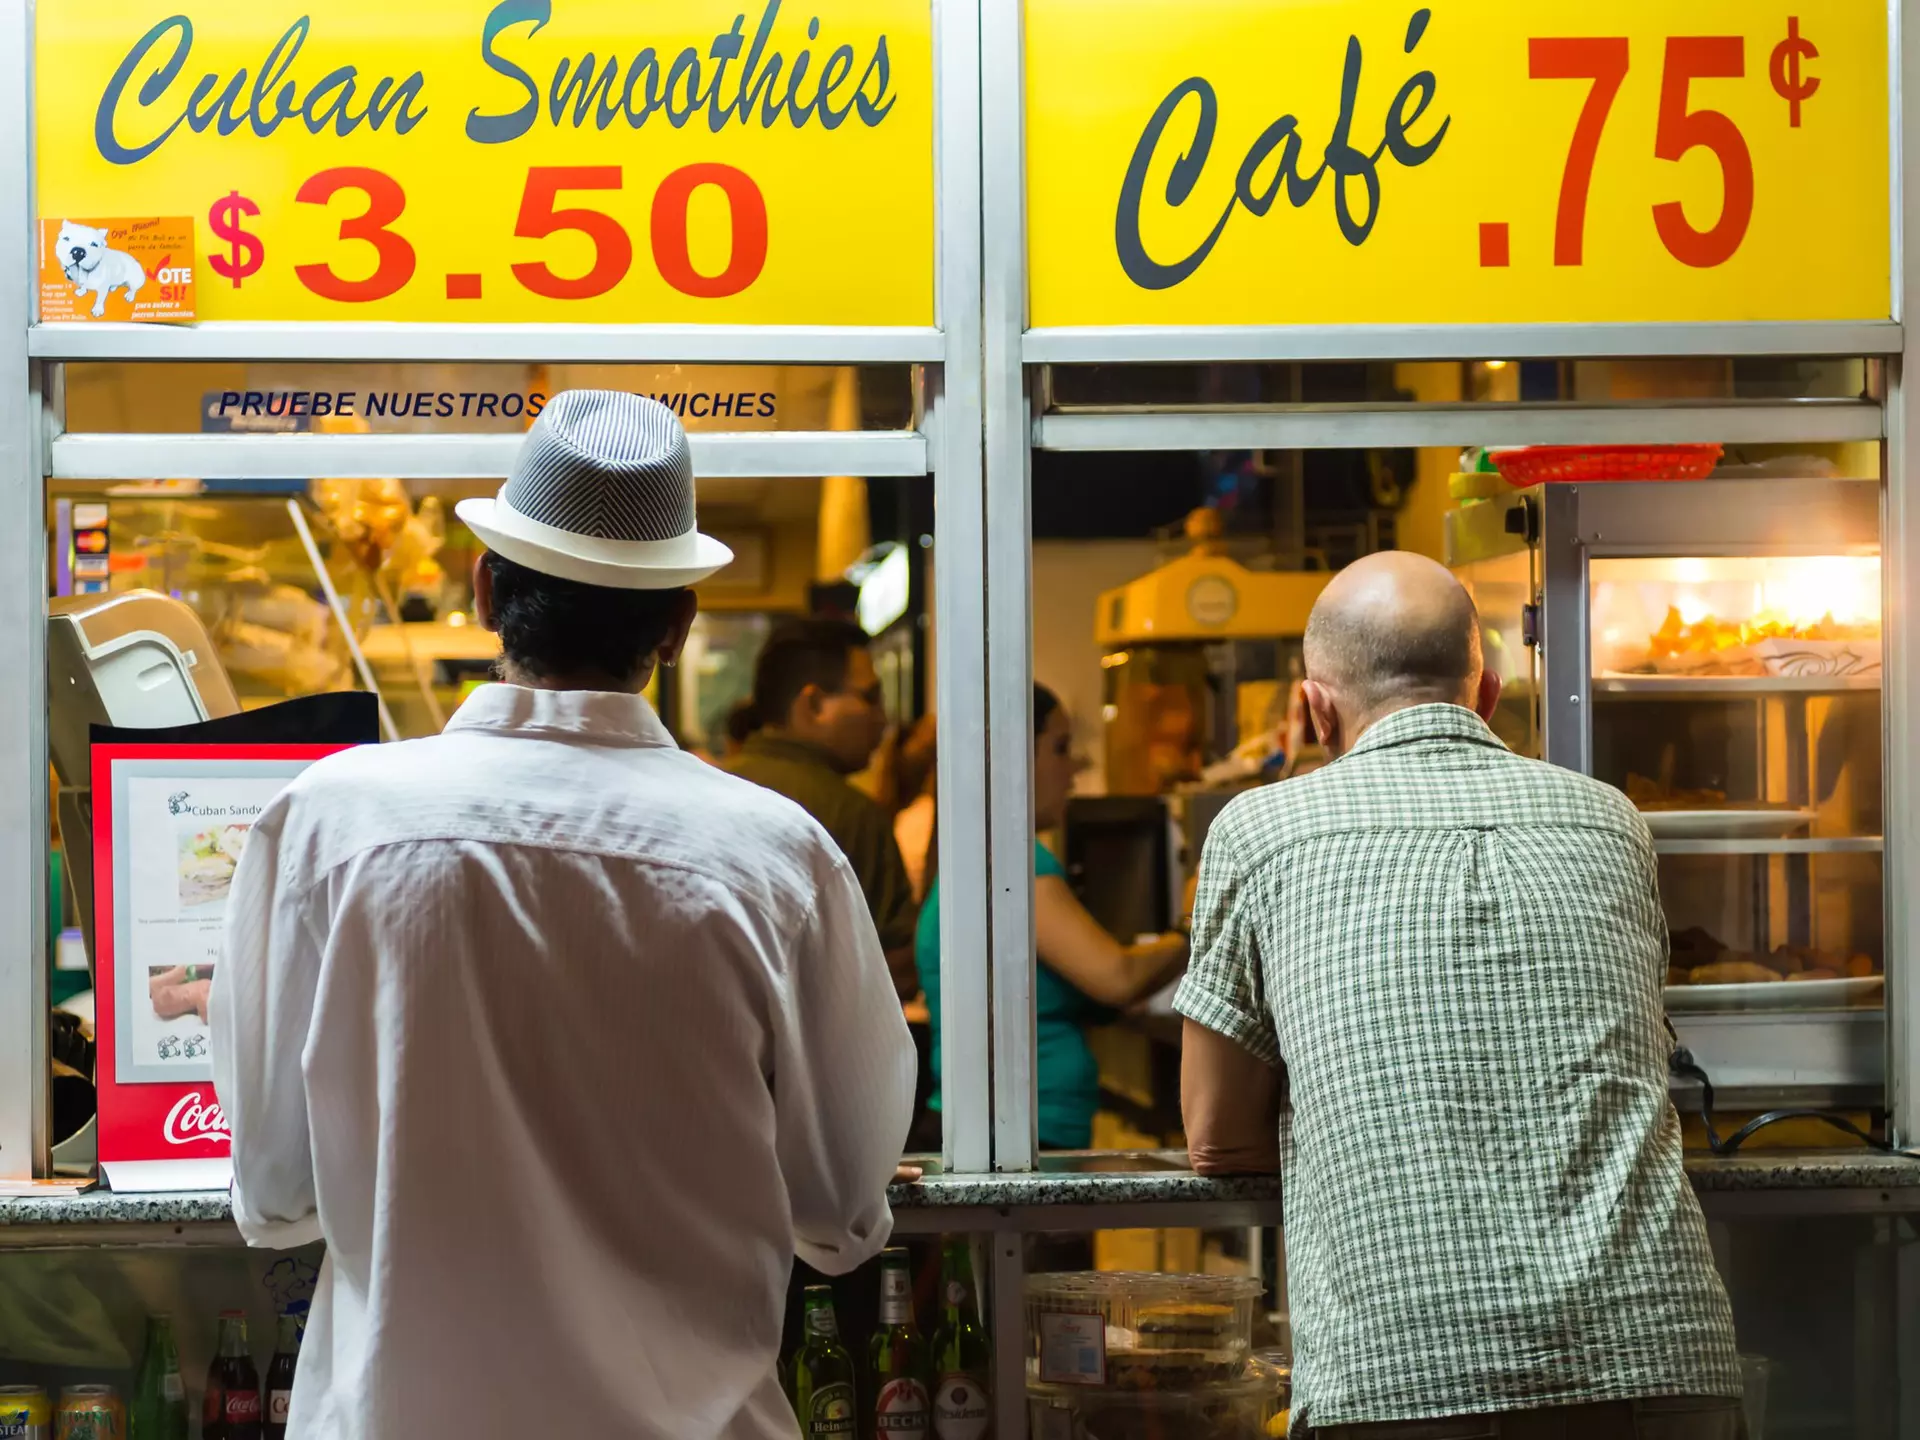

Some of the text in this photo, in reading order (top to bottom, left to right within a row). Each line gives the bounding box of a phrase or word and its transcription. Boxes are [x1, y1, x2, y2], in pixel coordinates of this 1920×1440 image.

[94, 0, 897, 165] Cuban Smoothies
[1114, 8, 1451, 291] Café
[218, 391, 356, 418] PRUEBE
[365, 391, 546, 418] NUESTROS
[634, 392, 777, 418] WICHES
[191, 804, 262, 816] Cuban Sandw
